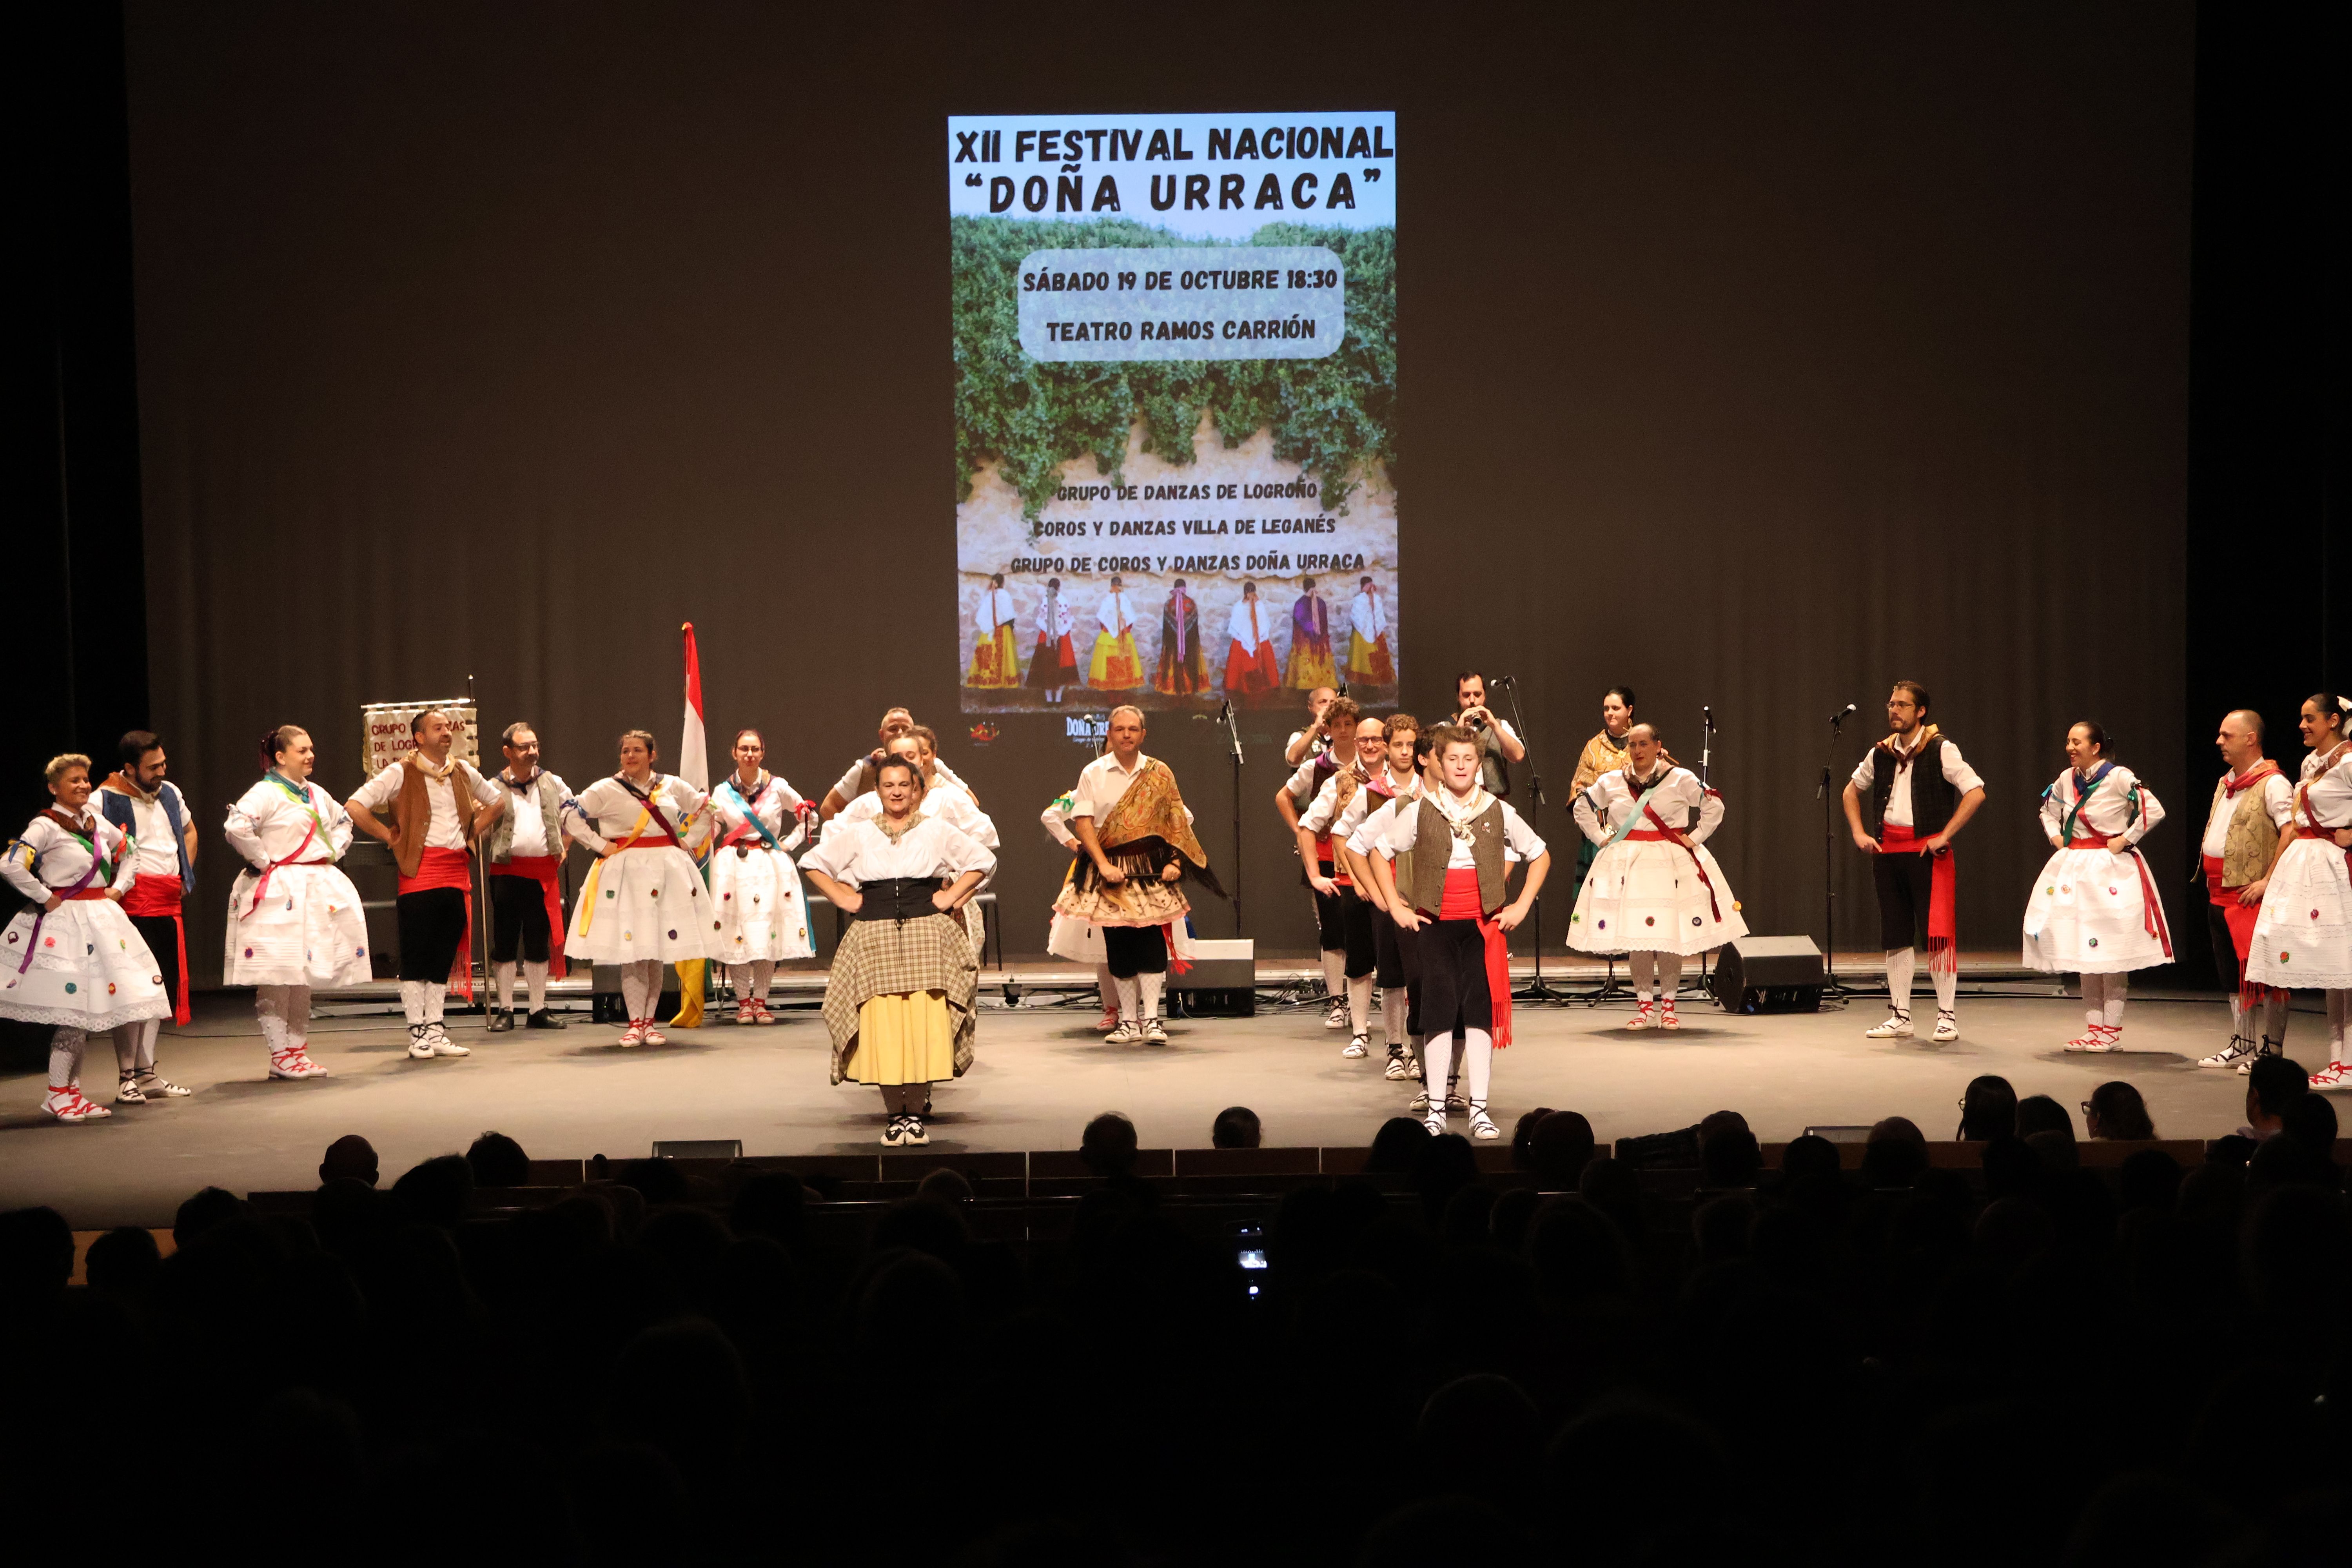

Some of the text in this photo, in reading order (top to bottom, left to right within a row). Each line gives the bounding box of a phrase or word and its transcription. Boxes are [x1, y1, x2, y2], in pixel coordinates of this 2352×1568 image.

[955, 126, 1393, 163] XII FESTIVAL NACIONAL
[1024, 267, 1337, 291] SÁBADO 19 DE OCTUBRE 18:30
[1047, 315, 1315, 341] TEATRO RAMOS CARRIÓN
[1057, 478, 1317, 501] GRUPO DE DANZAS DE LOGROÑO
[1034, 514, 1336, 536] COROS Y DANZAS VILLA DE LEGANÉS
[1011, 550, 1365, 572] GRUPO DE COROS Y DANZAS DOÑA URRACA
[372, 723, 406, 735] GRUPO
[374, 742, 386, 752] DE
